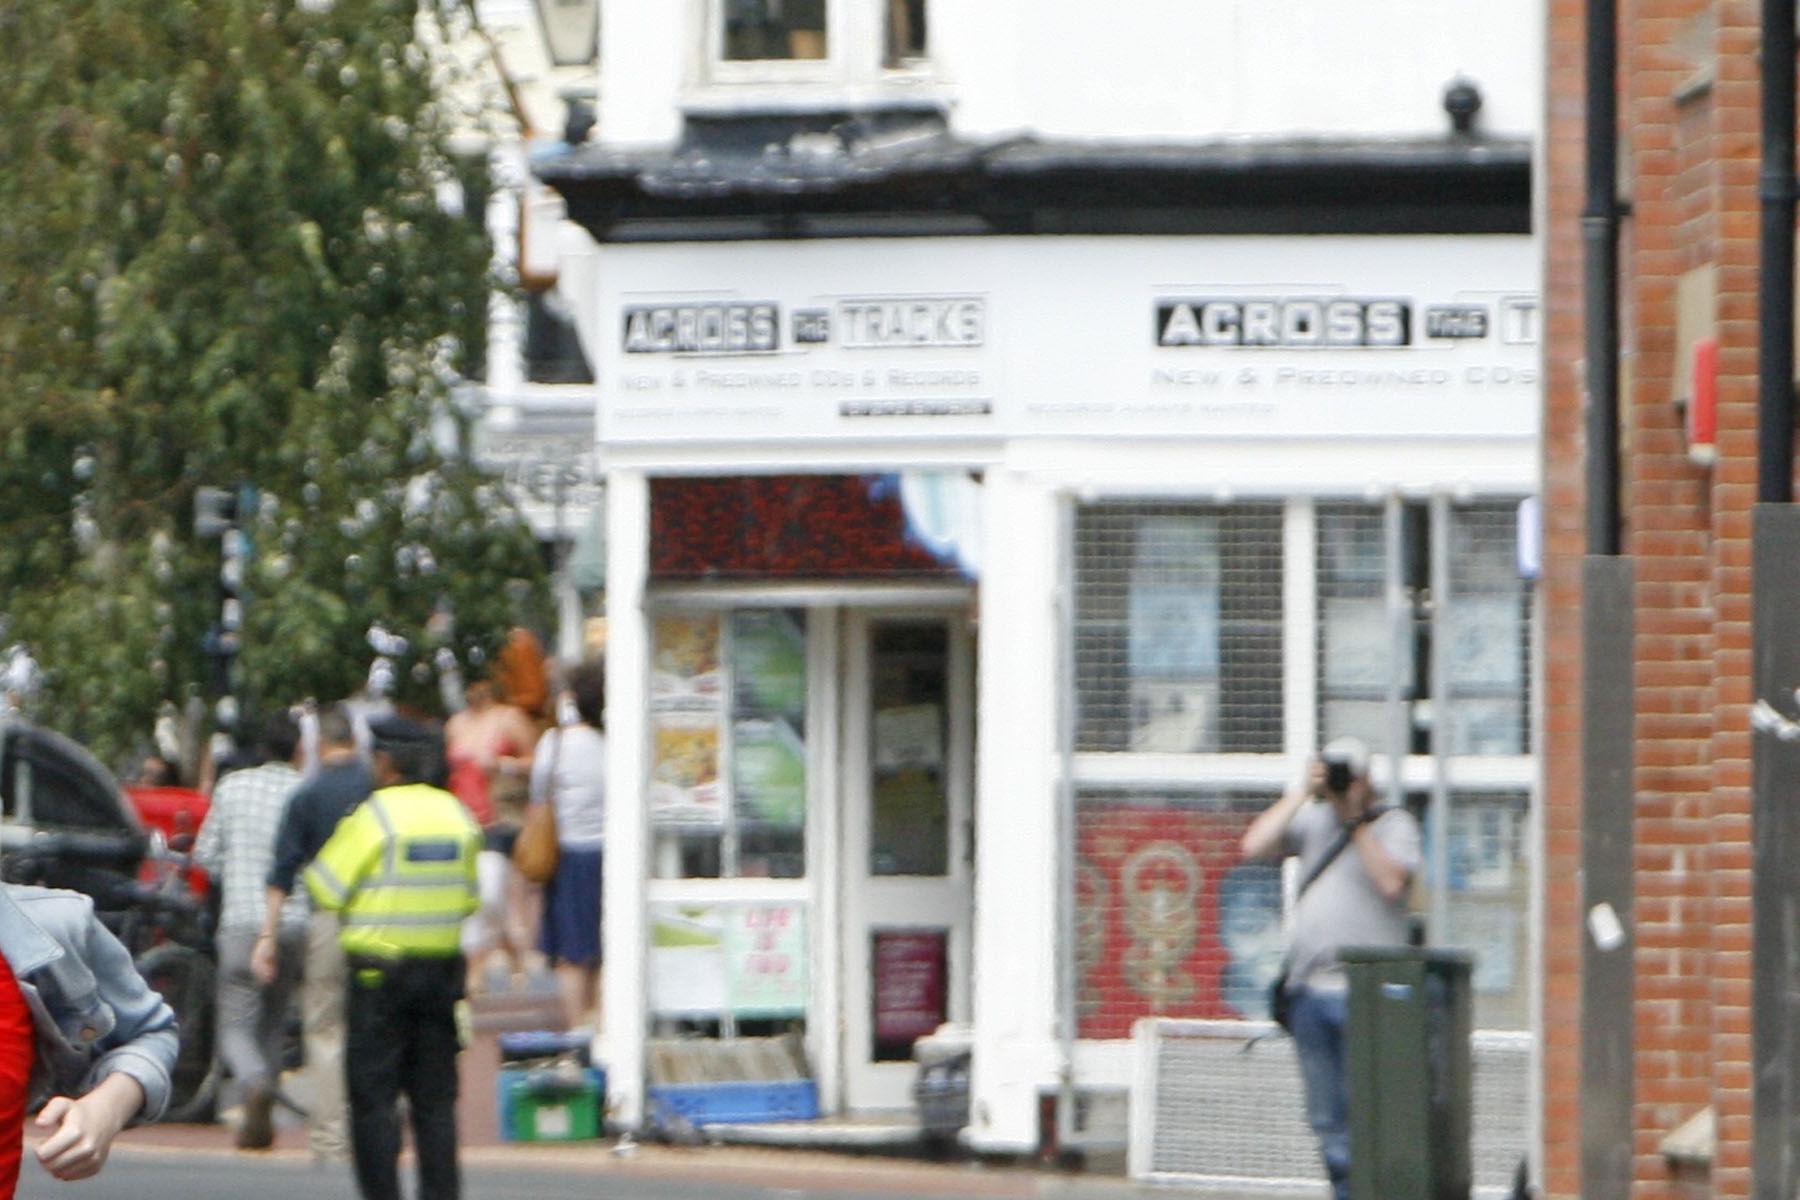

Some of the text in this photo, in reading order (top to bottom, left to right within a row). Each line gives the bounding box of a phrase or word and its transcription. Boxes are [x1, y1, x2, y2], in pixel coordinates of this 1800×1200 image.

[625, 304, 777, 351] ACROSS
[841, 302, 985, 346] TRACKS
[1158, 302, 1403, 346] ACROSS
[1427, 309, 1488, 337] THE
